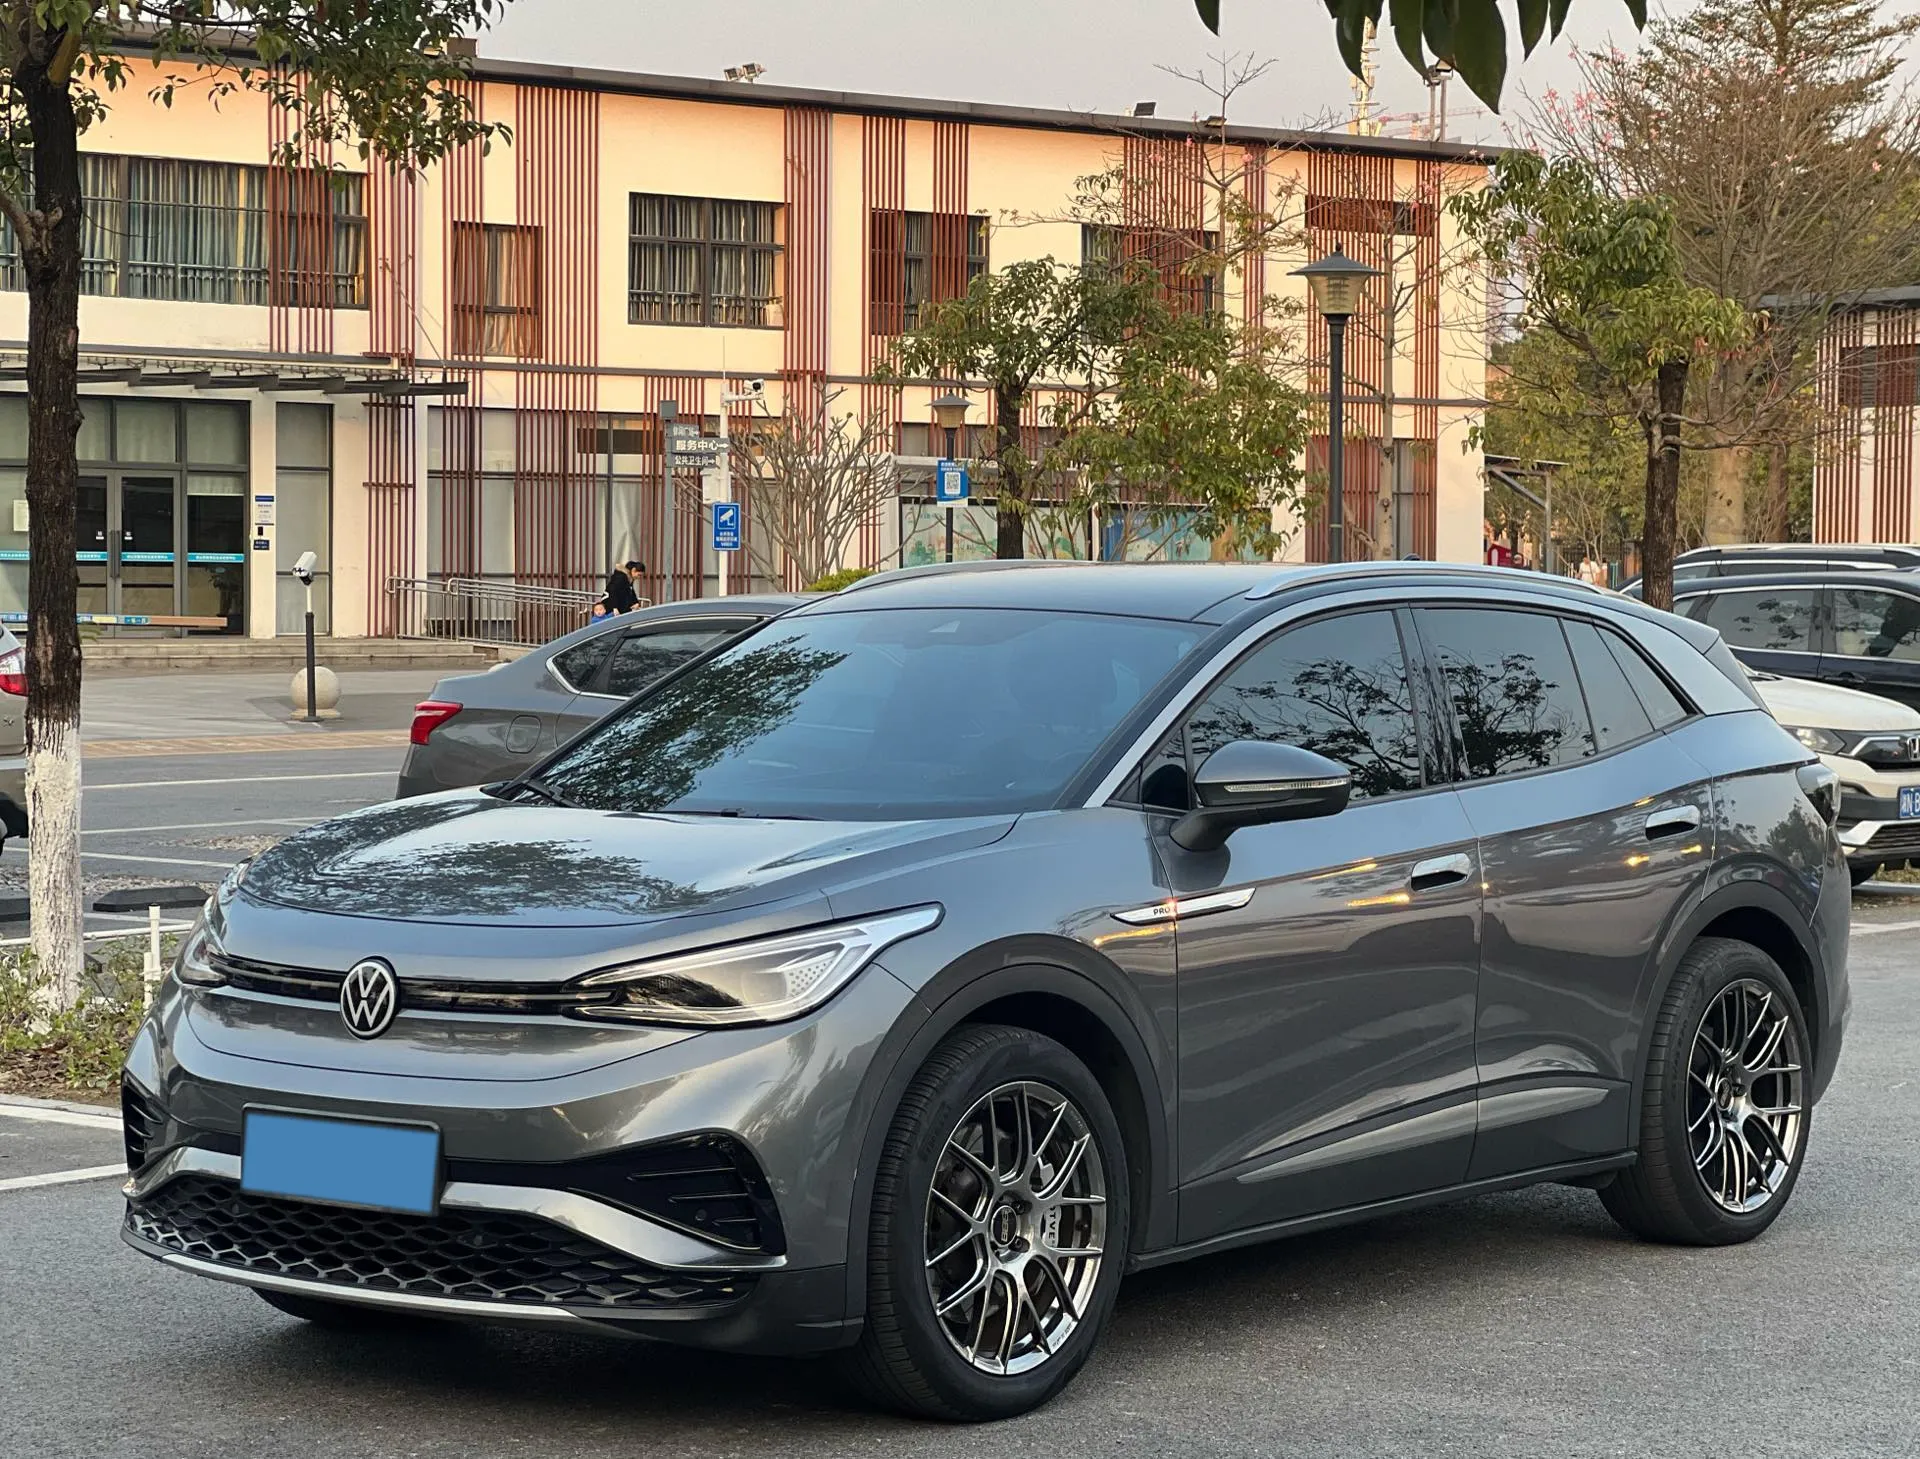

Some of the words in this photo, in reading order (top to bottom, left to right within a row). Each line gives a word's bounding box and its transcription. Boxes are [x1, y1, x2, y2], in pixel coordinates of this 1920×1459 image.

[676, 440, 718, 451] 服务中心
[675, 455, 708, 466] 公共卫生间
[1153, 907, 1170, 915] PRO
